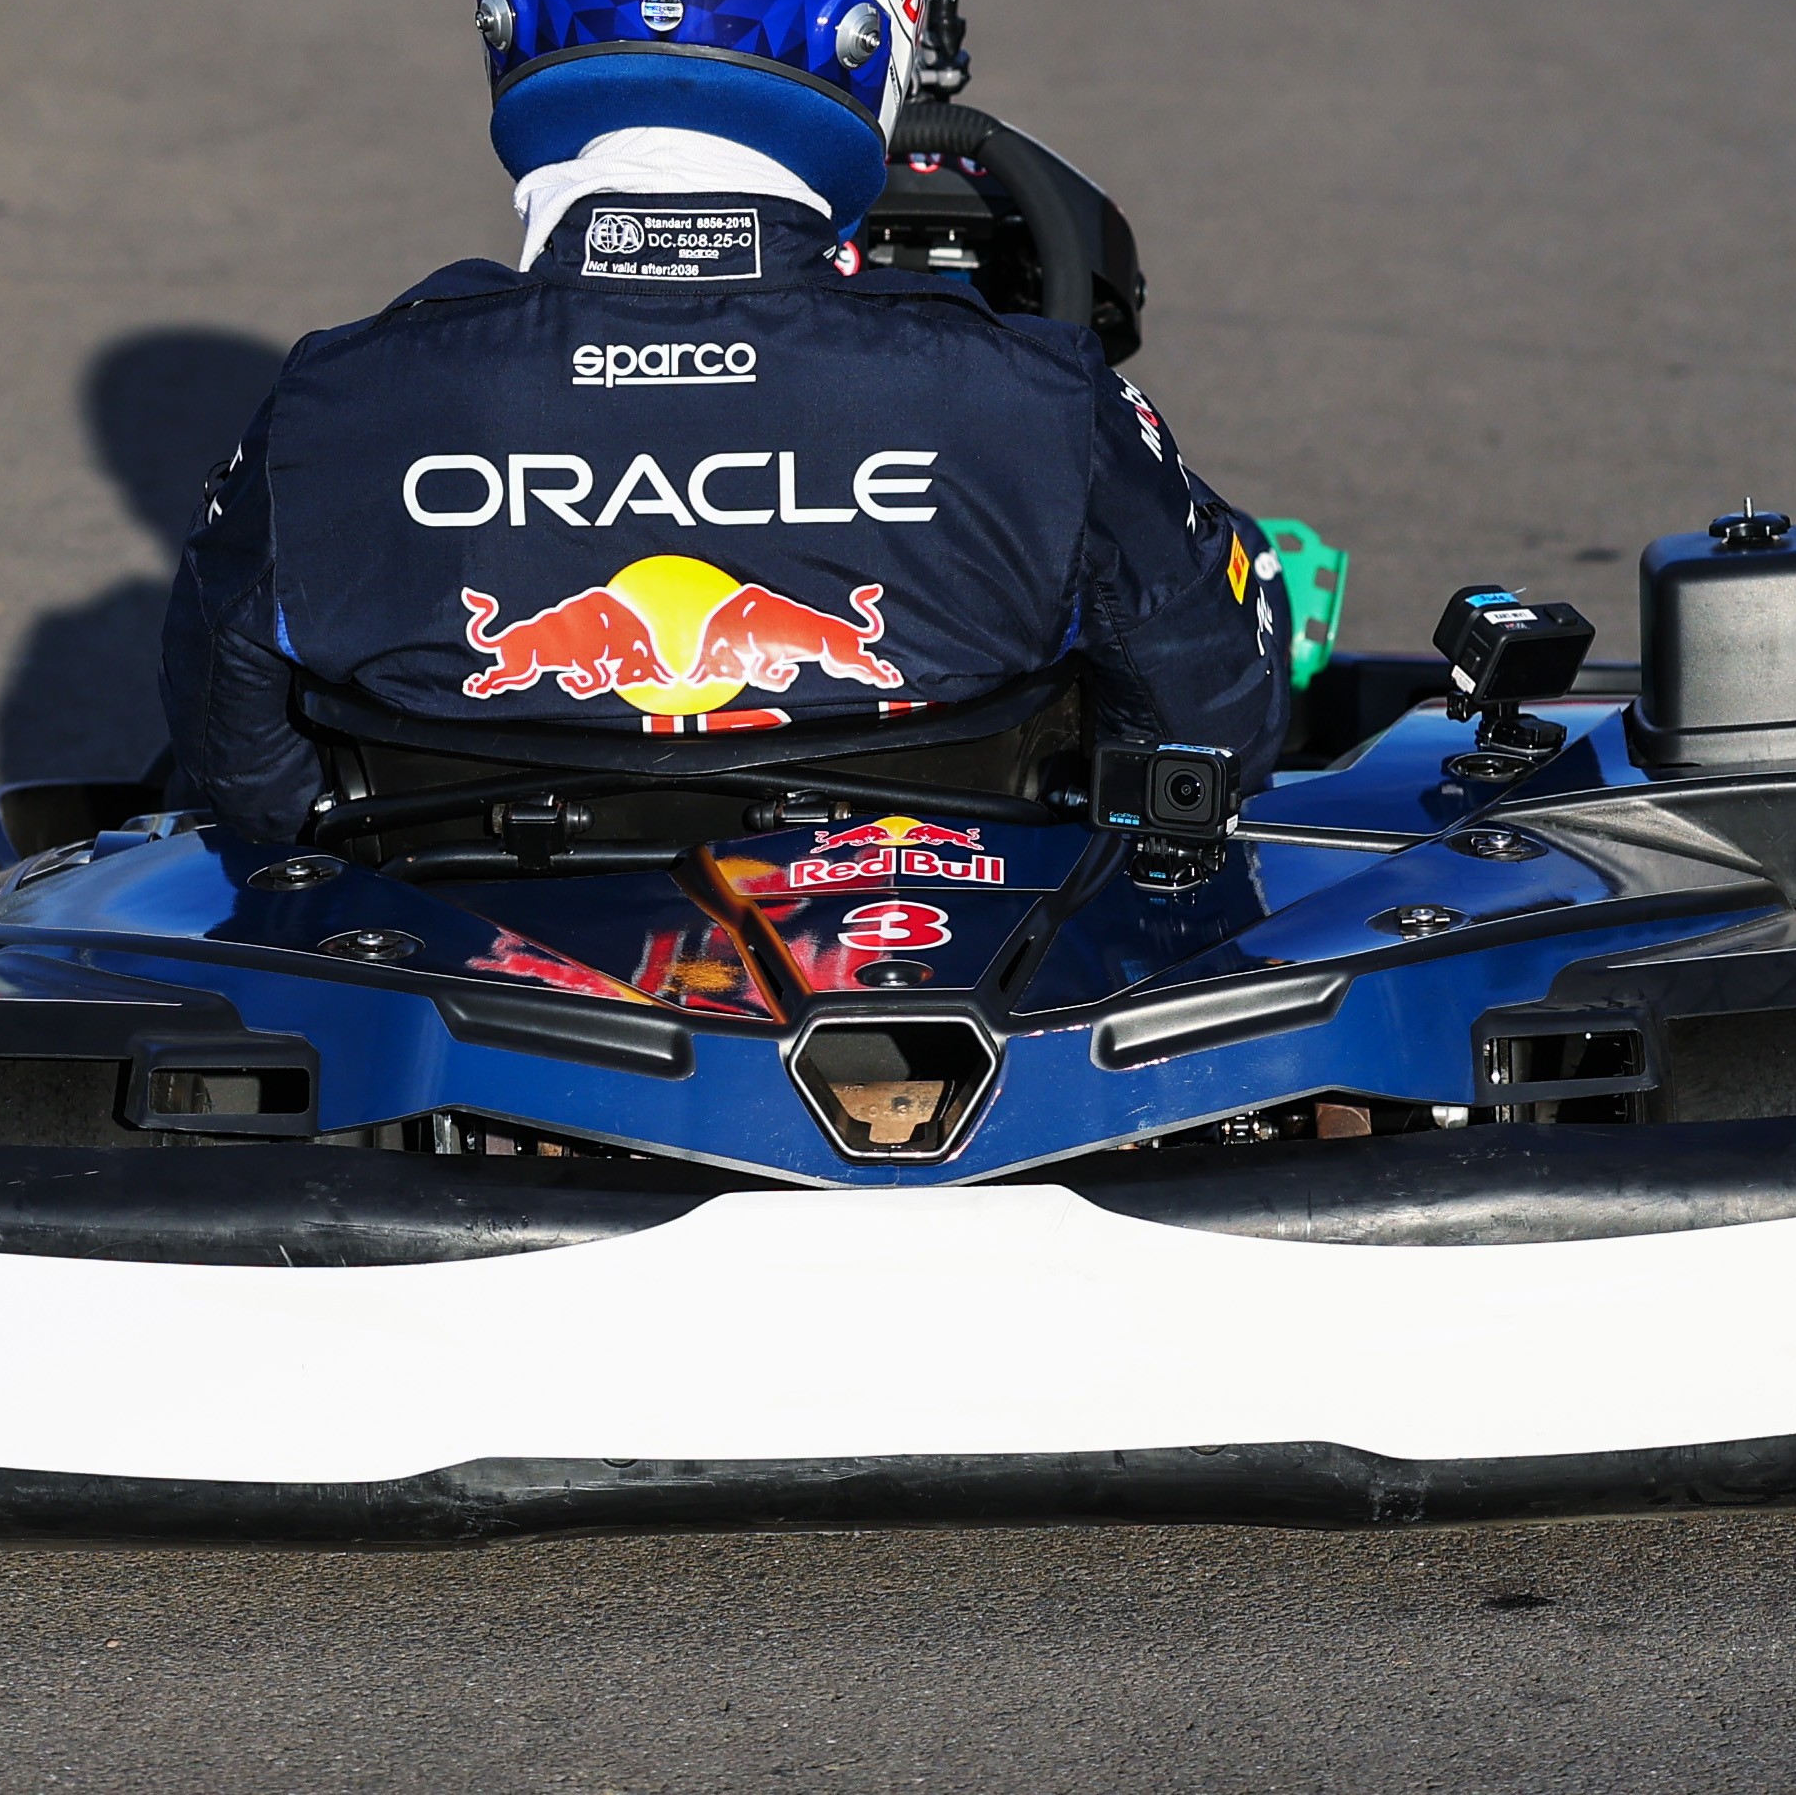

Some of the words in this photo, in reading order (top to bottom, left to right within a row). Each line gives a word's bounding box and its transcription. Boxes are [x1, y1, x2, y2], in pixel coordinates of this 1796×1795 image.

[593, 223, 640, 247] FIA
[644, 216, 692, 229] Standard
[588, 260, 608, 272] Not
[612, 261, 637, 274] valid
[572, 341, 756, 387] sparco
[403, 451, 938, 527] ORACLE
[790, 848, 896, 887] Red
[901, 849, 1004, 884] Bull
[837, 900, 952, 951] 3
